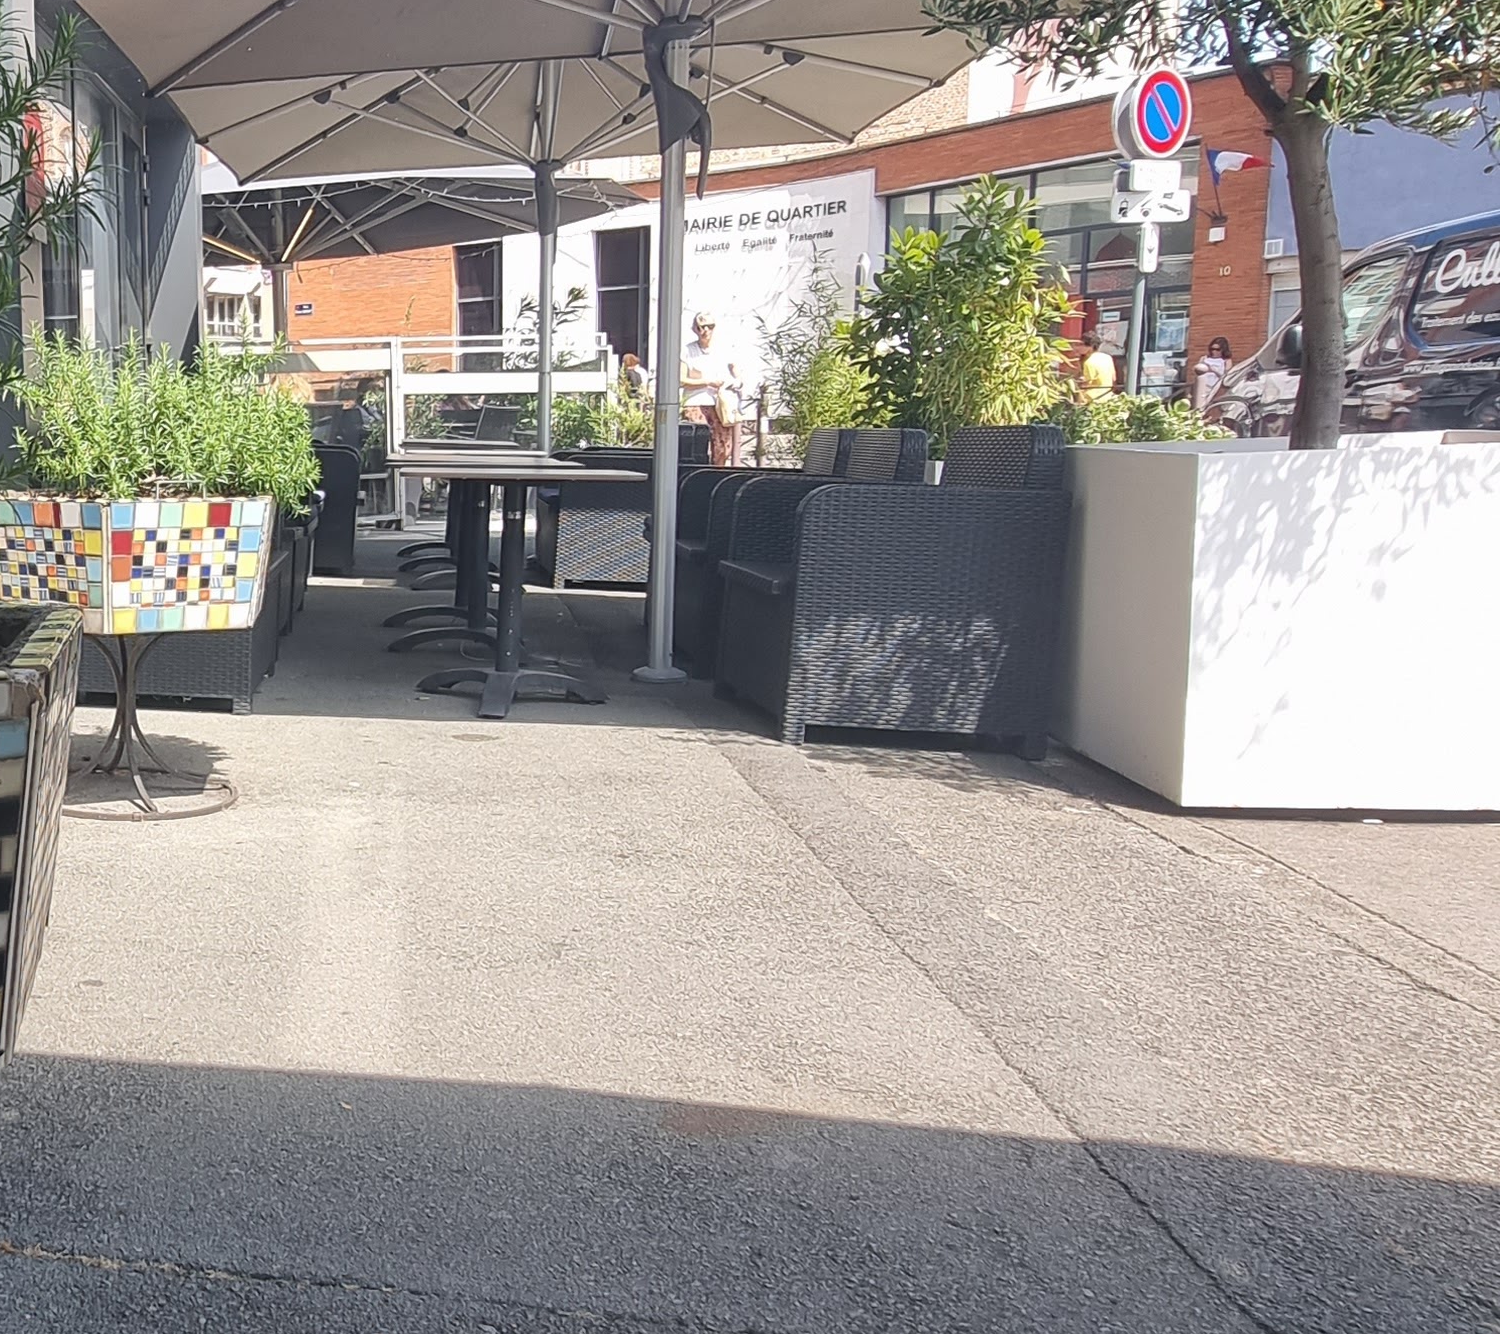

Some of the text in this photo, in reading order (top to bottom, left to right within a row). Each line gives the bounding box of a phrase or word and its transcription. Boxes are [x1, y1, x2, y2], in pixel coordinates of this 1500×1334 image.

[739, 211, 761, 226] DE
[766, 200, 847, 223] QUARTIER
[788, 229, 834, 243] Fraternité
[1219, 265, 1231, 276] 10
